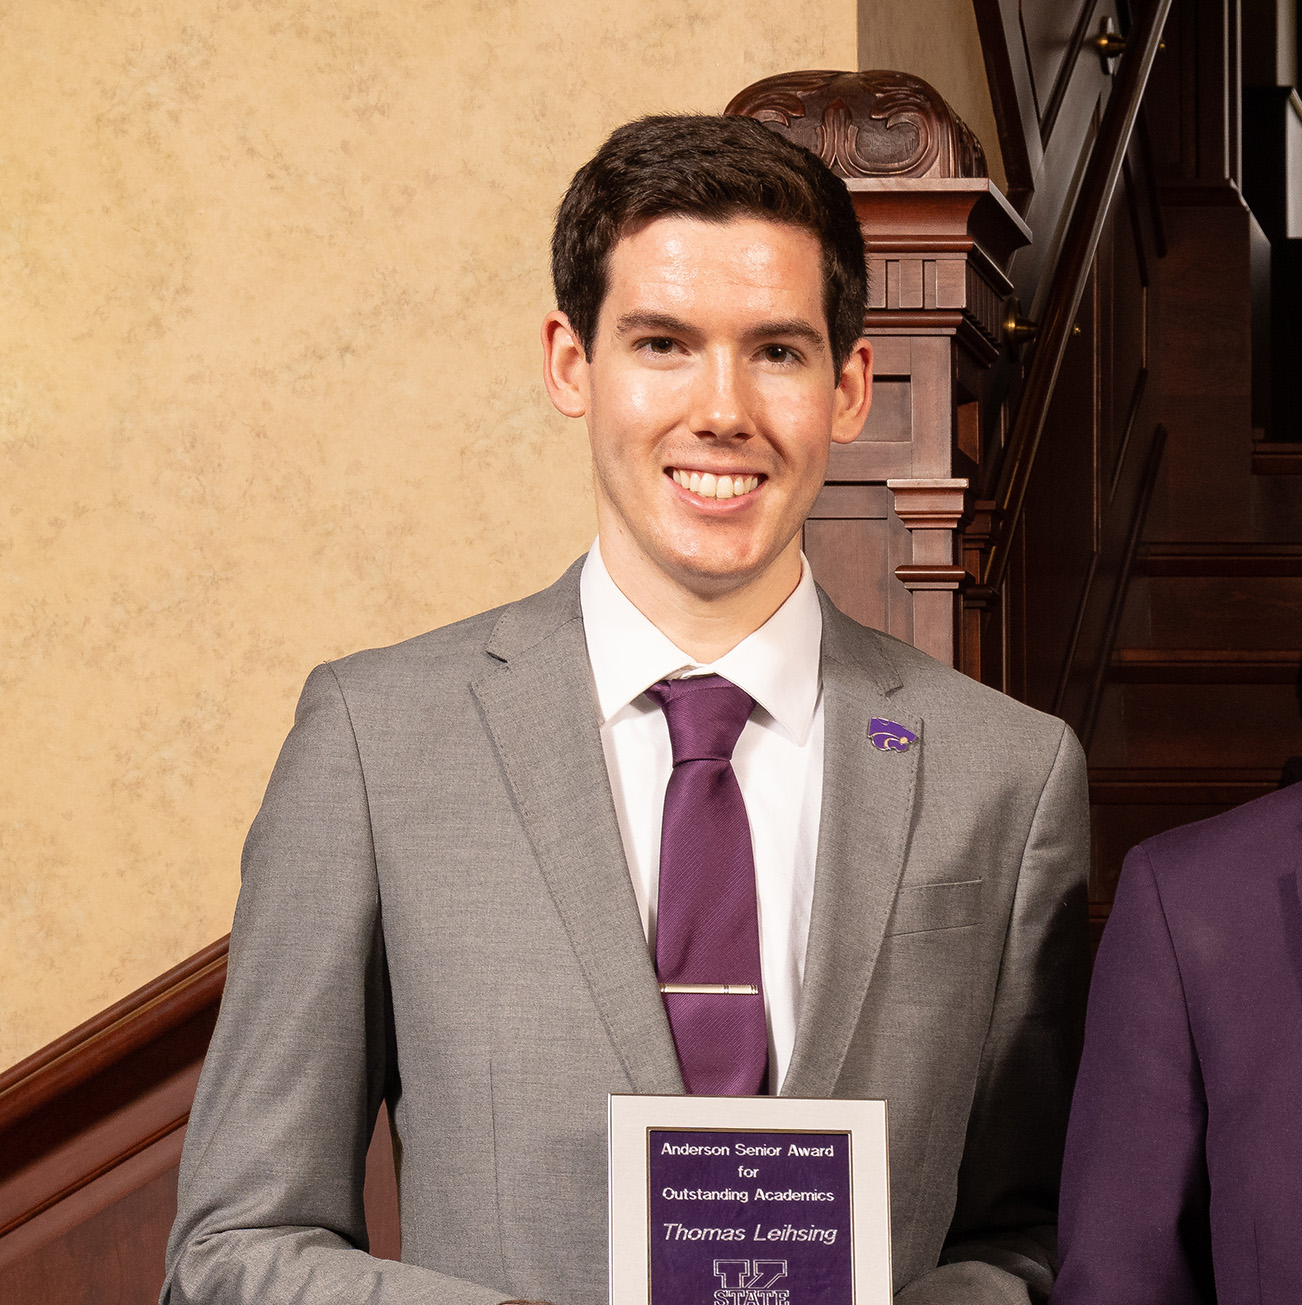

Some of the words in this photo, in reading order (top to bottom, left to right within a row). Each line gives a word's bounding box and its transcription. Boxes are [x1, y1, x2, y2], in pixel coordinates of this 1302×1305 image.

[660, 1142, 730, 1157] Anderson
[734, 1143, 783, 1157] Senior
[787, 1144, 835, 1158] Award
[737, 1165, 759, 1179] for
[662, 1187, 749, 1203] Outstanding
[753, 1188, 835, 1202] Academics
[663, 1223, 746, 1242] Thomas
[753, 1224, 838, 1245] Leihsing
